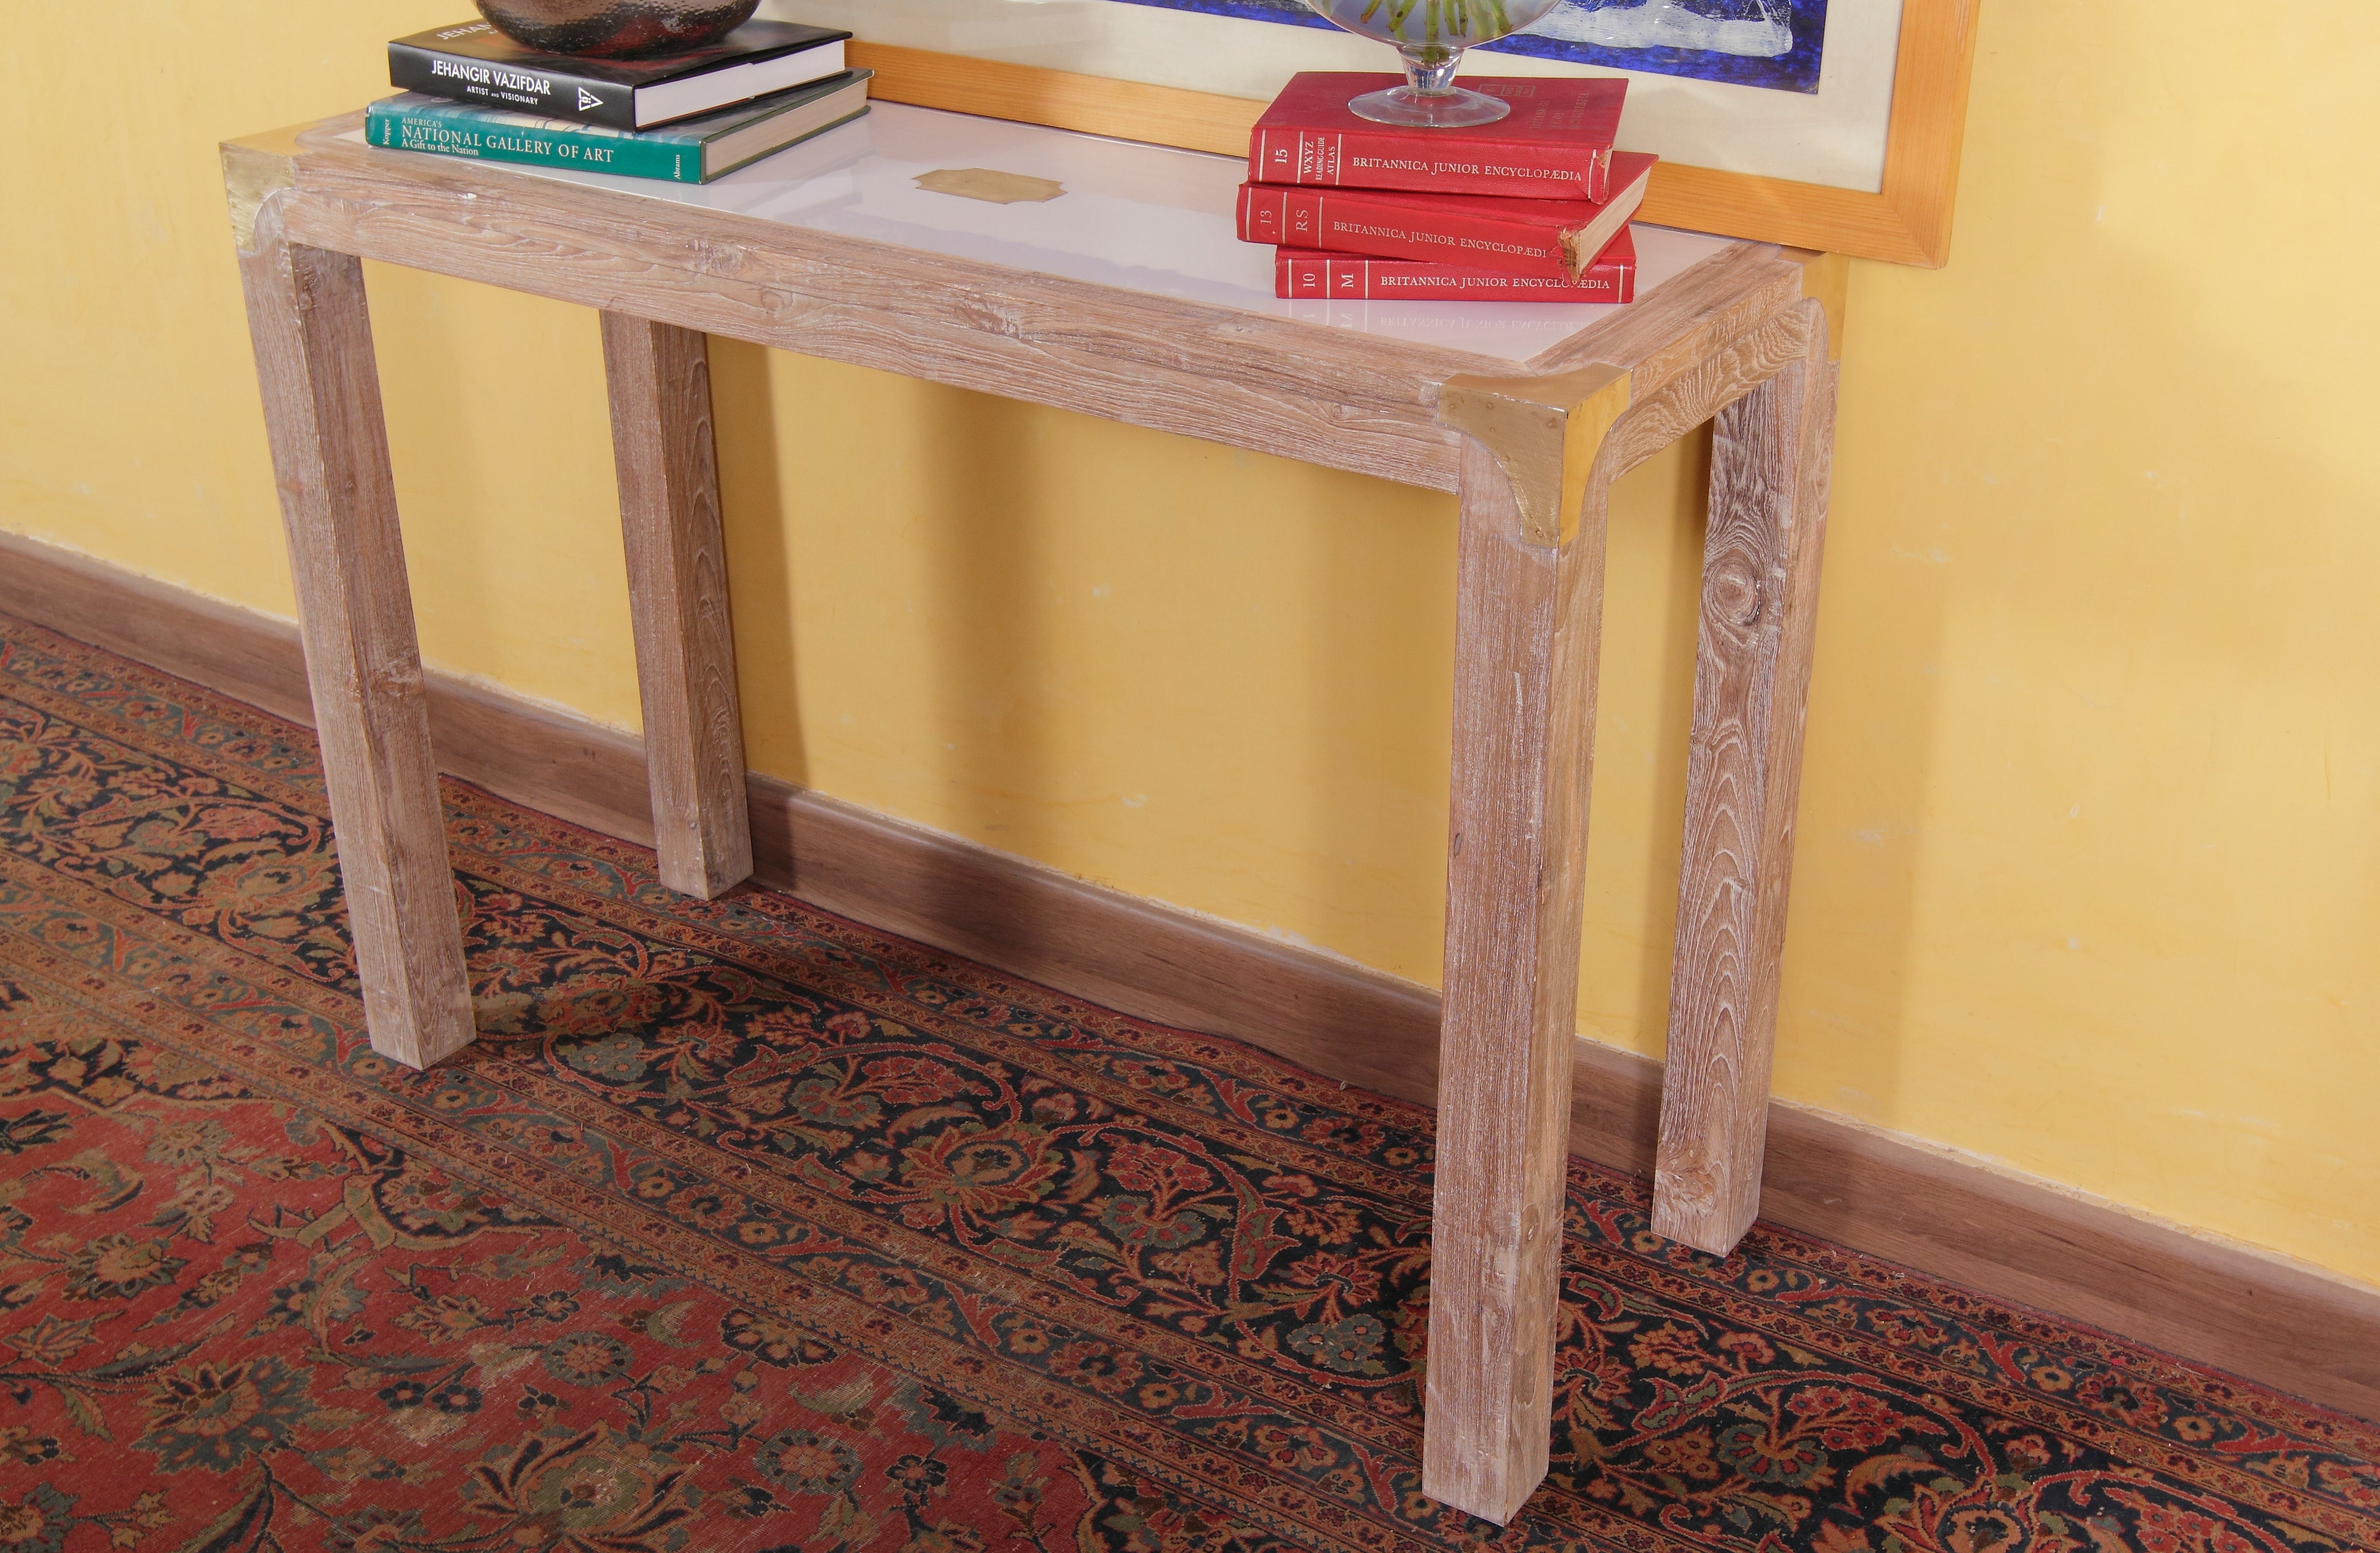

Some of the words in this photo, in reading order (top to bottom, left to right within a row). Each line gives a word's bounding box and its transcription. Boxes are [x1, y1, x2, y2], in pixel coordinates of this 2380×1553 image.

[437, 22, 492, 40] JEHAN
[432, 60, 490, 84] JEHANGIR
[493, 72, 550, 95] VAZIFDAR
[467, 86, 489, 96] ARTIST
[501, 91, 538, 105] VISIONARY
[402, 117, 442, 128] AMERICA'S
[402, 125, 482, 146] NATIONAL
[486, 135, 552, 155] GALLERY
[558, 144, 578, 158] OF
[583, 147, 614, 162] ART
[402, 138, 409, 148] A
[410, 138, 425, 150] Gift
[428, 142, 436, 151] to
[438, 142, 450, 153] the
[452, 144, 479, 155] Nation
[1275, 149, 1287, 164] 15
[1303, 141, 1313, 174] WXYZ
[1353, 157, 1428, 171] BRITANNICA
[1431, 162, 1479, 175] JUNIOR
[1485, 166, 1582, 181] ENCYCLOPÆDIA
[1260, 210, 1271, 224] 13
[1334, 221, 1406, 239] BRITANNICA
[1409, 232, 1456, 246] JUNIOR
[1460, 238, 1546, 258] ENCYCLOPÆDI
[1303, 273, 1315, 288] 10
[1341, 273, 1354, 288] M
[1381, 276, 1457, 286] BRITANNICA
[1459, 277, 1507, 288] JUNIOR
